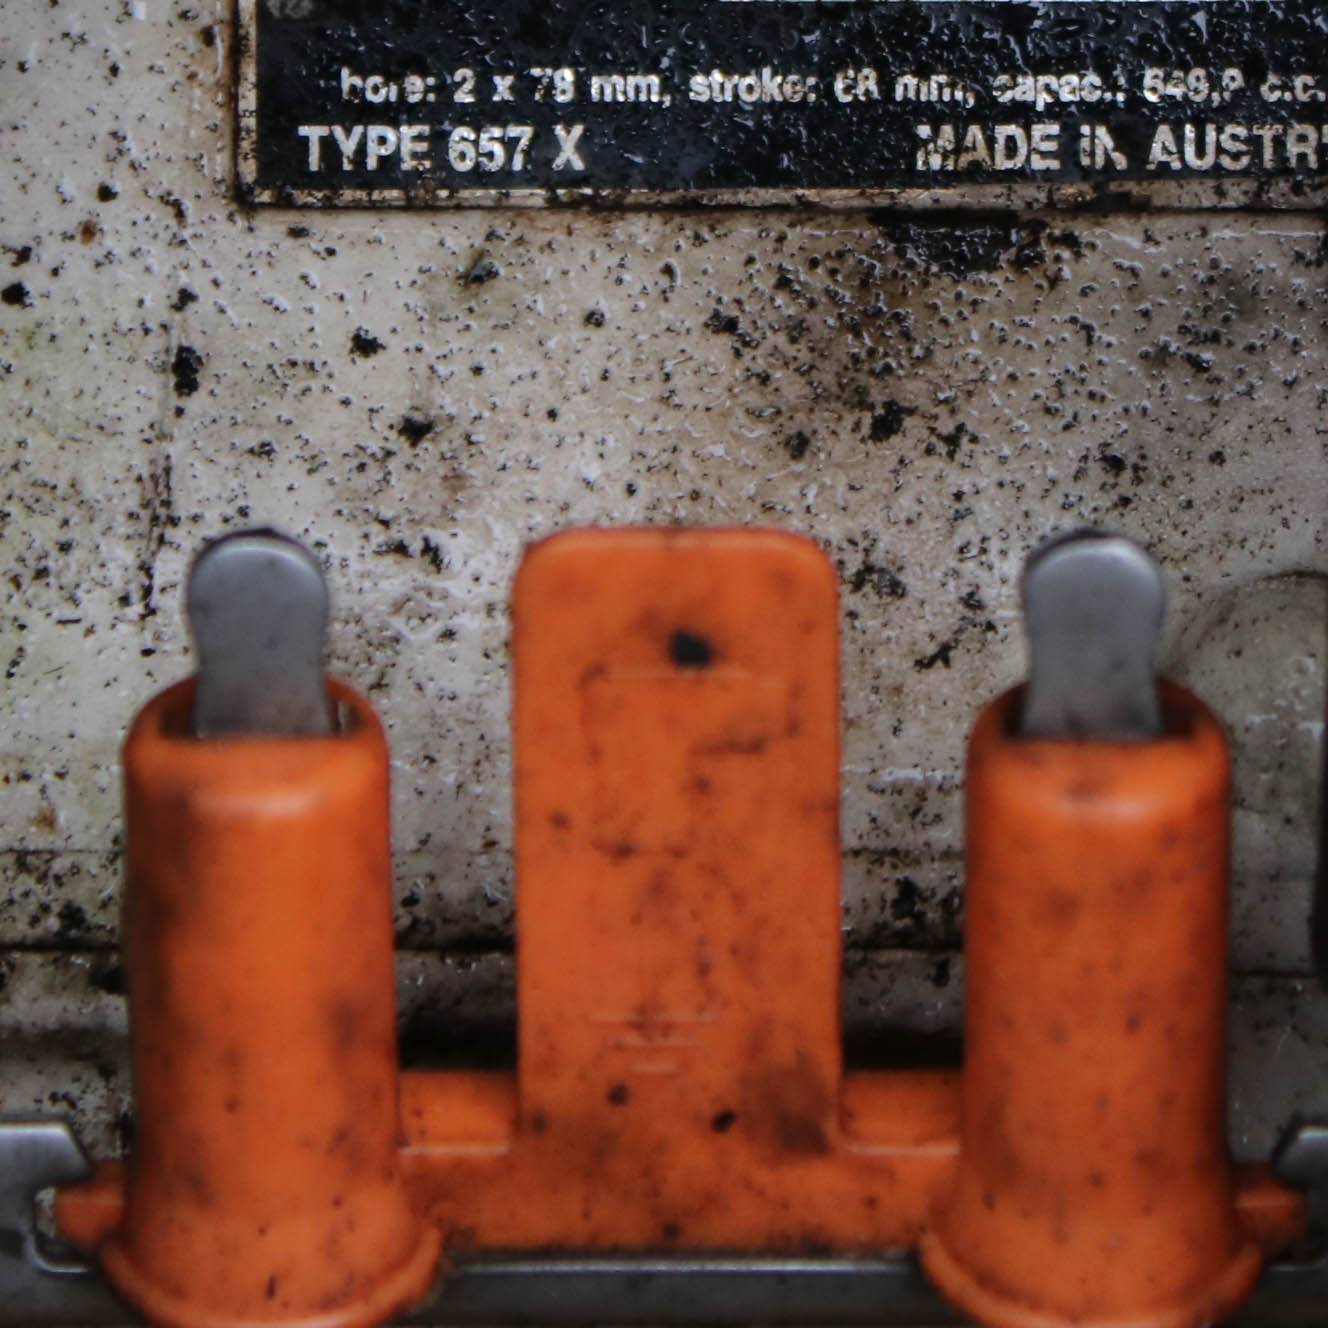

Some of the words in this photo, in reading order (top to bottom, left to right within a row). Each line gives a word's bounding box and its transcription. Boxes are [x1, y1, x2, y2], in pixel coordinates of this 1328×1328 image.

[453, 68, 476, 103] 2
[492, 74, 515, 102] x
[591, 74, 671, 109] mm,
[688, 66, 818, 103] stroke:
[298, 125, 429, 171] TYPE
[449, 125, 533, 171] 657
[553, 125, 586, 170] X
[915, 124, 1062, 171] MADE
[1079, 124, 1128, 170] IN
